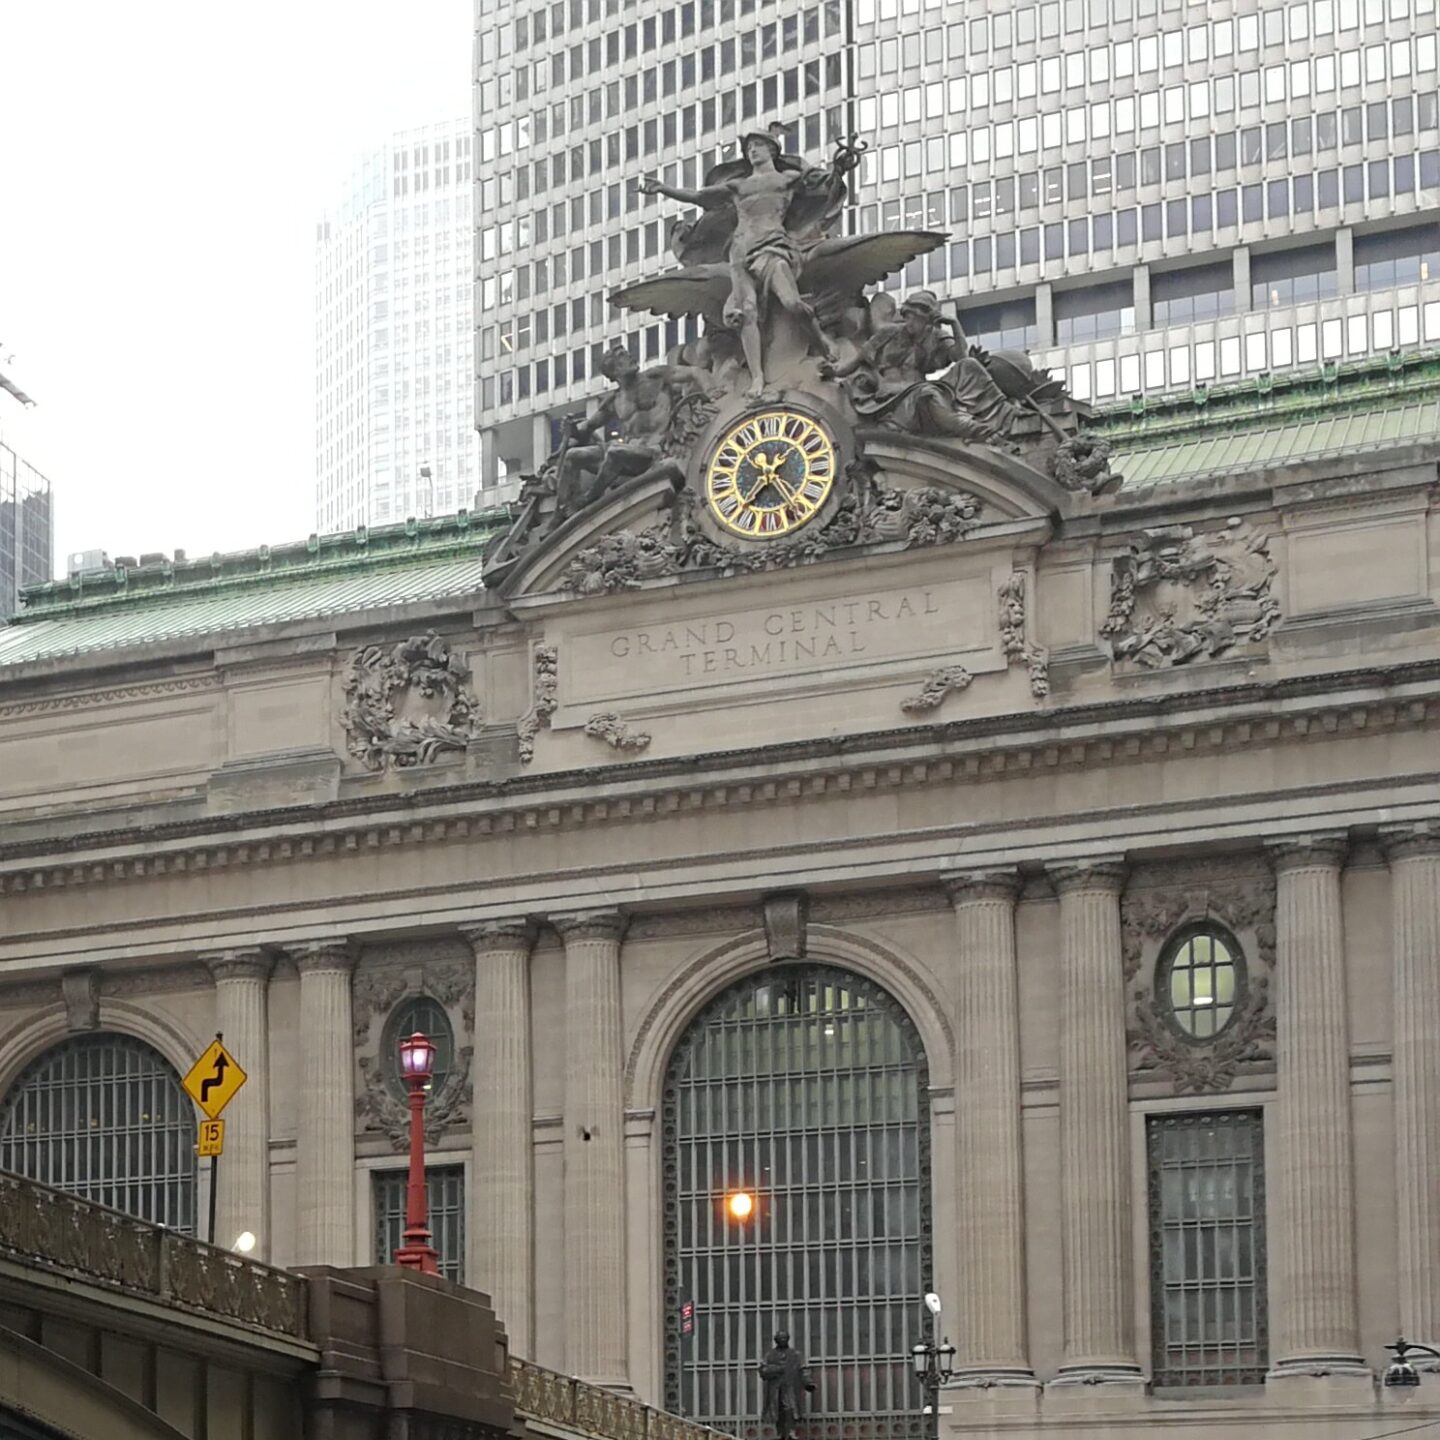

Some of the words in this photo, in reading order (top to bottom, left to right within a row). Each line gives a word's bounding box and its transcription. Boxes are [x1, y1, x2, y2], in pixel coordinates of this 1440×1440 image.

[610, 621, 736, 659] GRAND
[764, 591, 940, 637] CENTRAL
[680, 630, 867, 676] TERMINAL
[205, 1124, 219, 1141] 15
